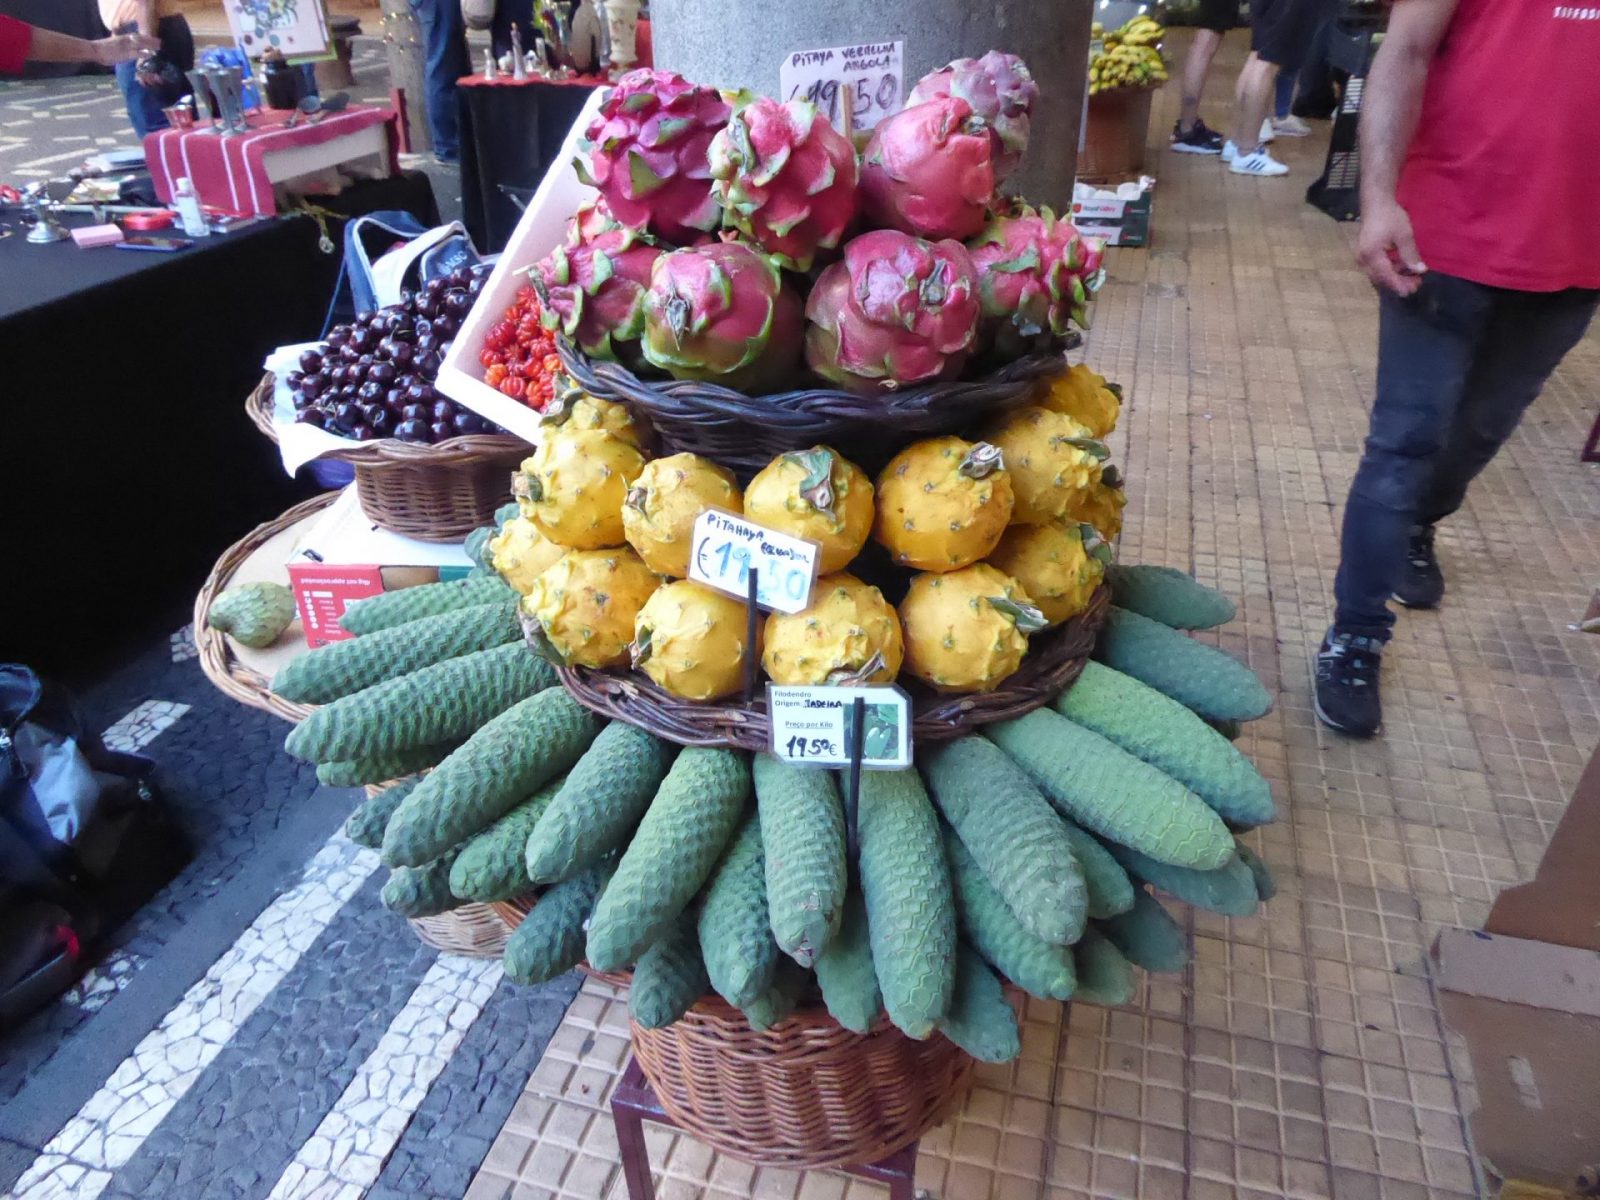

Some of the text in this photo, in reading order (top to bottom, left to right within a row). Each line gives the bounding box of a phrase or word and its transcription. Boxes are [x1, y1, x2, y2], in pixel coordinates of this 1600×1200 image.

[843, 55, 890, 72] ANGOLA
[774, 690, 812, 698] Filodendro
[785, 720, 833, 729] Preço por Kilo
